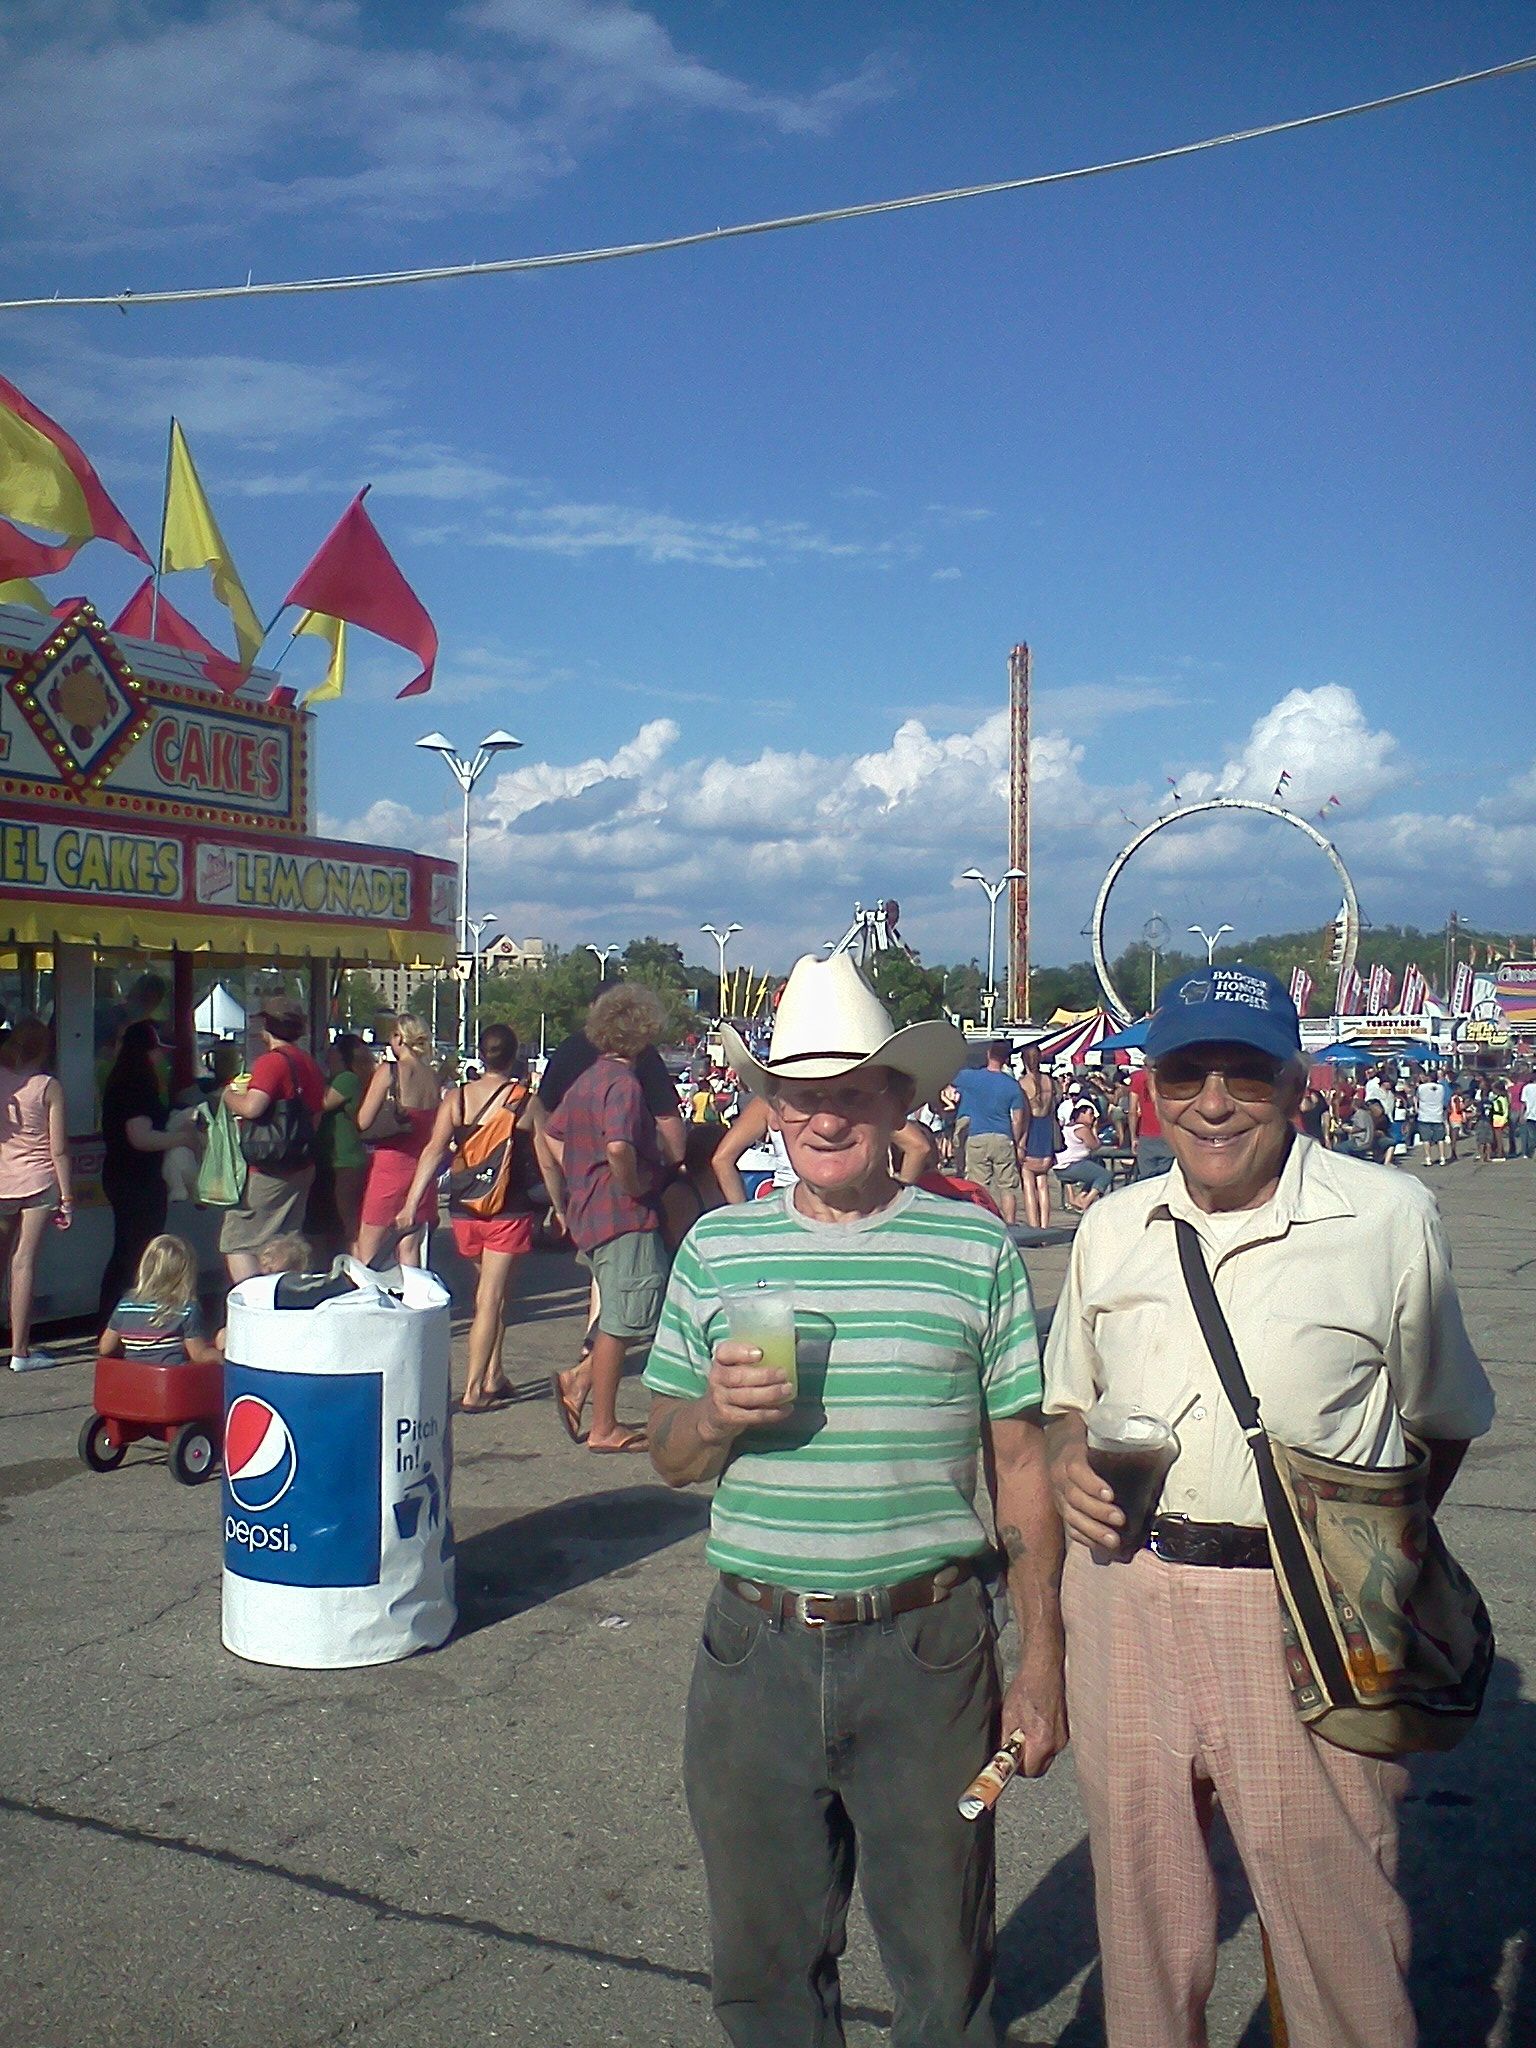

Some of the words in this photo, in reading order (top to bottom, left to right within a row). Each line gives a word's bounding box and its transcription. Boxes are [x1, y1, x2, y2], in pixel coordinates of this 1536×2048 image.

[152, 716, 283, 801] CAKES
[54, 829, 180, 897] CAKES
[236, 852, 410, 919] LEMONADE
[1213, 971, 1267, 988] BADGER
[1217, 981, 1265, 997] HONOR
[1214, 991, 1269, 1008] FLIGHT
[1366, 1019, 1399, 1027] TURKEY
[397, 1417, 438, 1445] Pitch
[397, 1446, 419, 1475] In!
